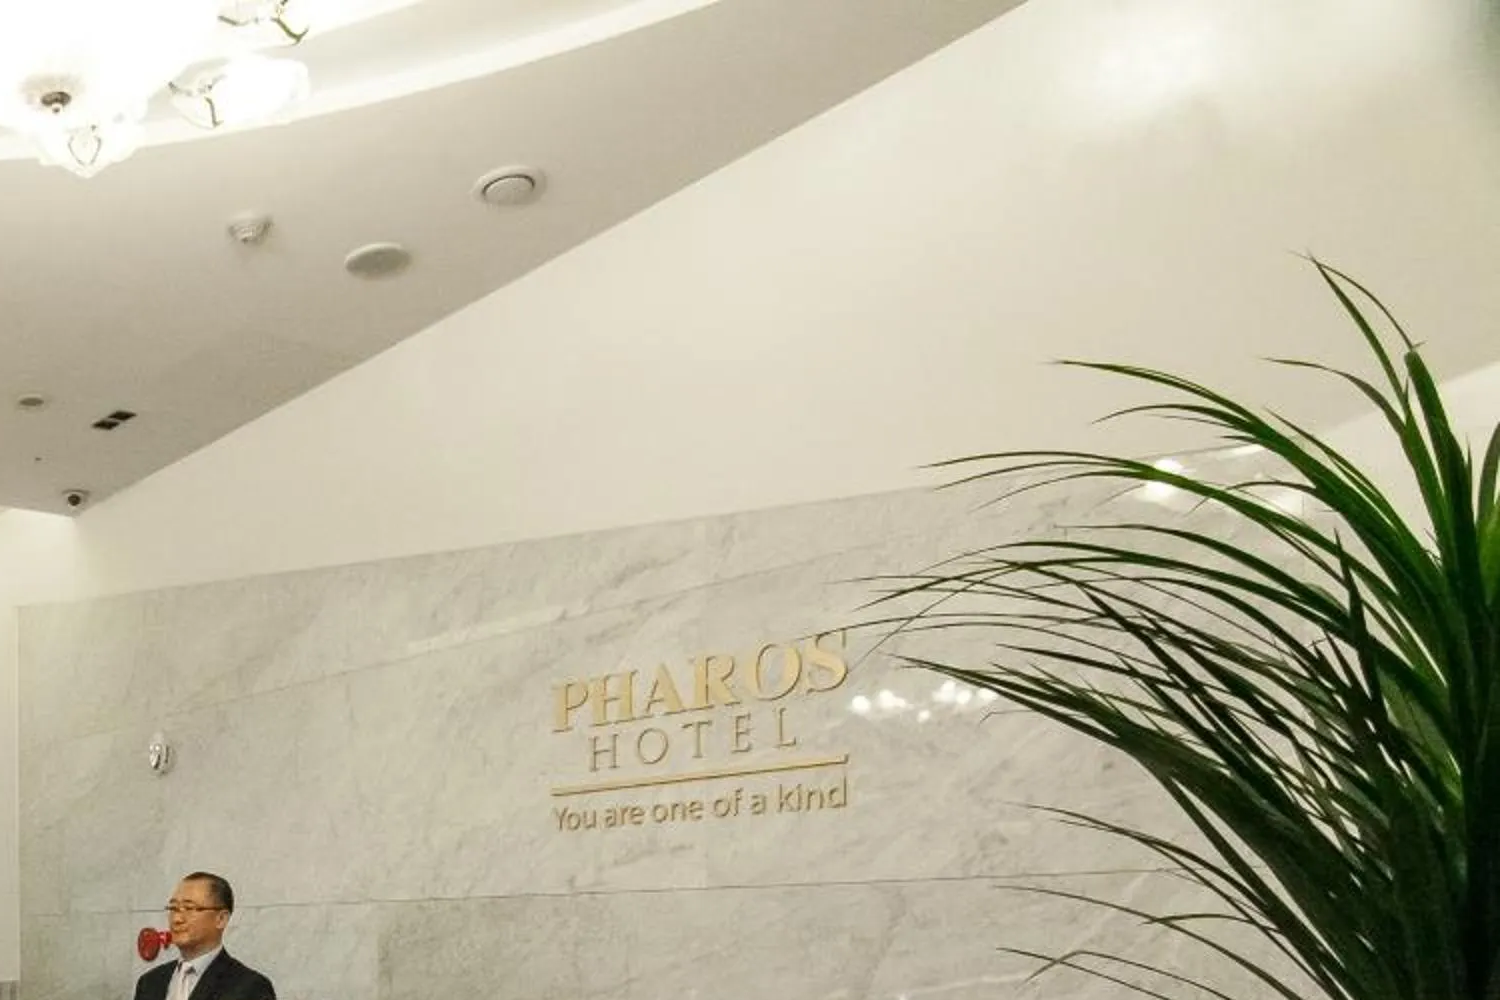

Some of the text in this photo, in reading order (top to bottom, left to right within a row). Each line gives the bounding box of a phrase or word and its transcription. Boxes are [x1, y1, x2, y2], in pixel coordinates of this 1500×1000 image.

[552, 631, 850, 733] PHAROS
[588, 706, 798, 772] HOTEL
[554, 775, 848, 831] You are one of a kind
